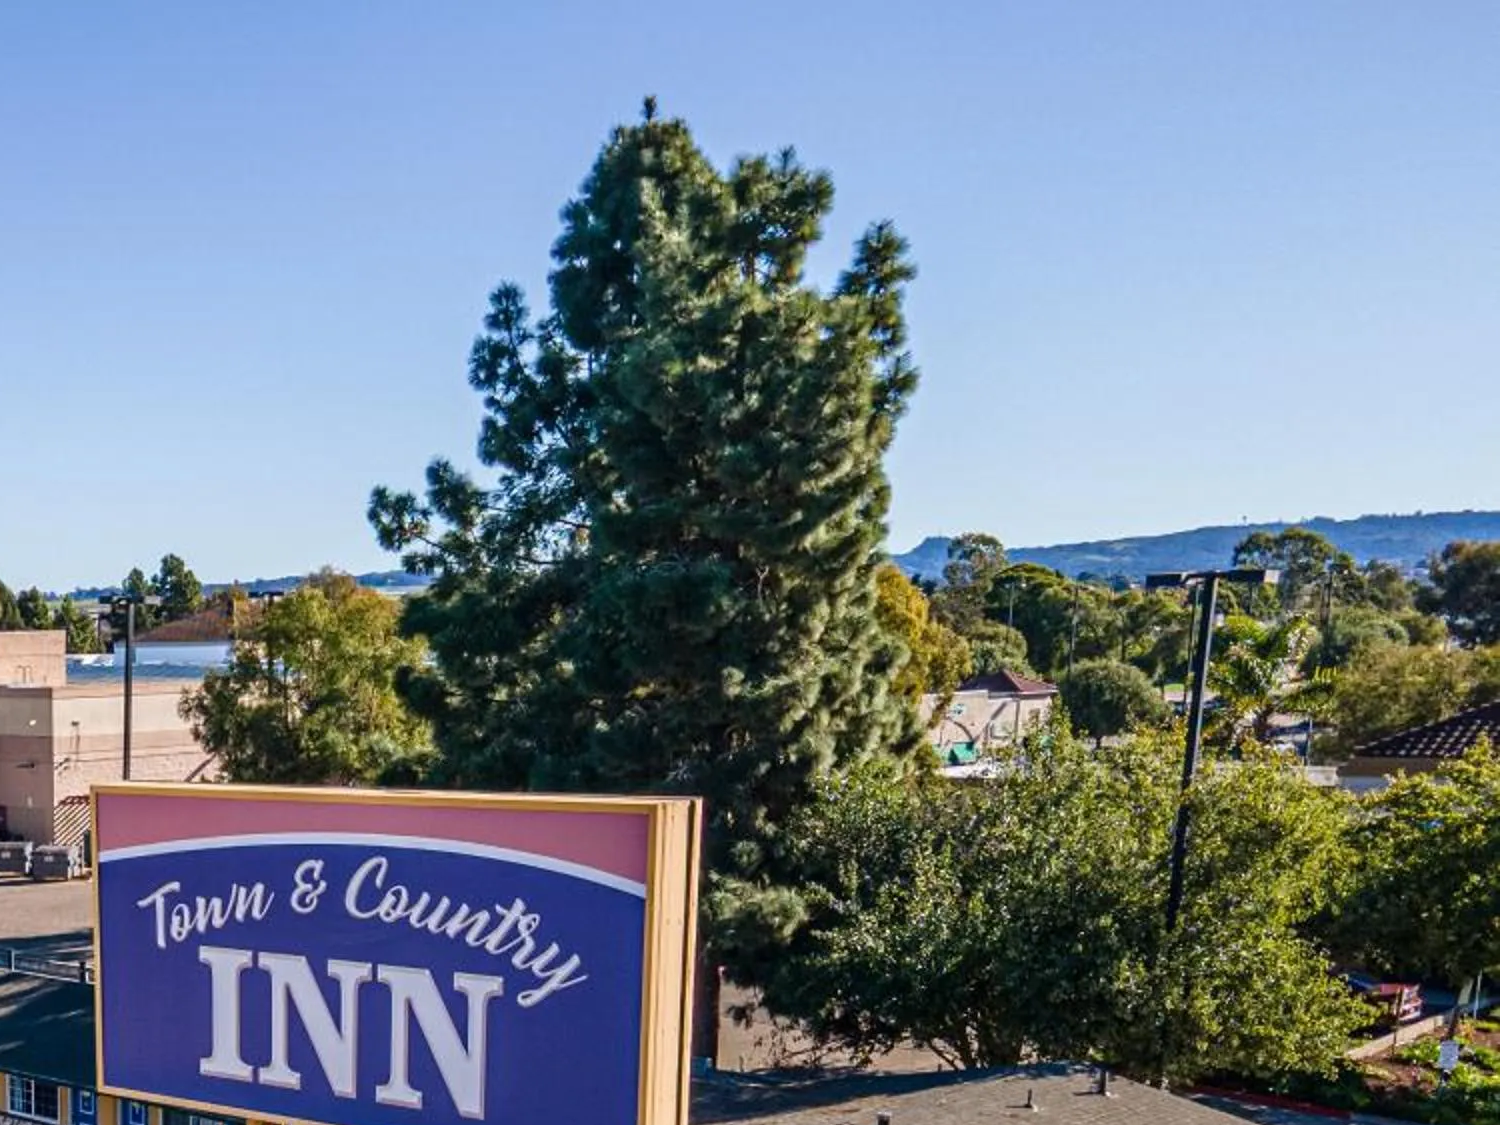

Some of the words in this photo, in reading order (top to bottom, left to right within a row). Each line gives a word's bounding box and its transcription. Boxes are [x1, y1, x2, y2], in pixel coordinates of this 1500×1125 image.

[137, 880, 274, 949] Town
[290, 858, 327, 914] &
[344, 856, 588, 1008] Country
[199, 945, 504, 1121] INN
